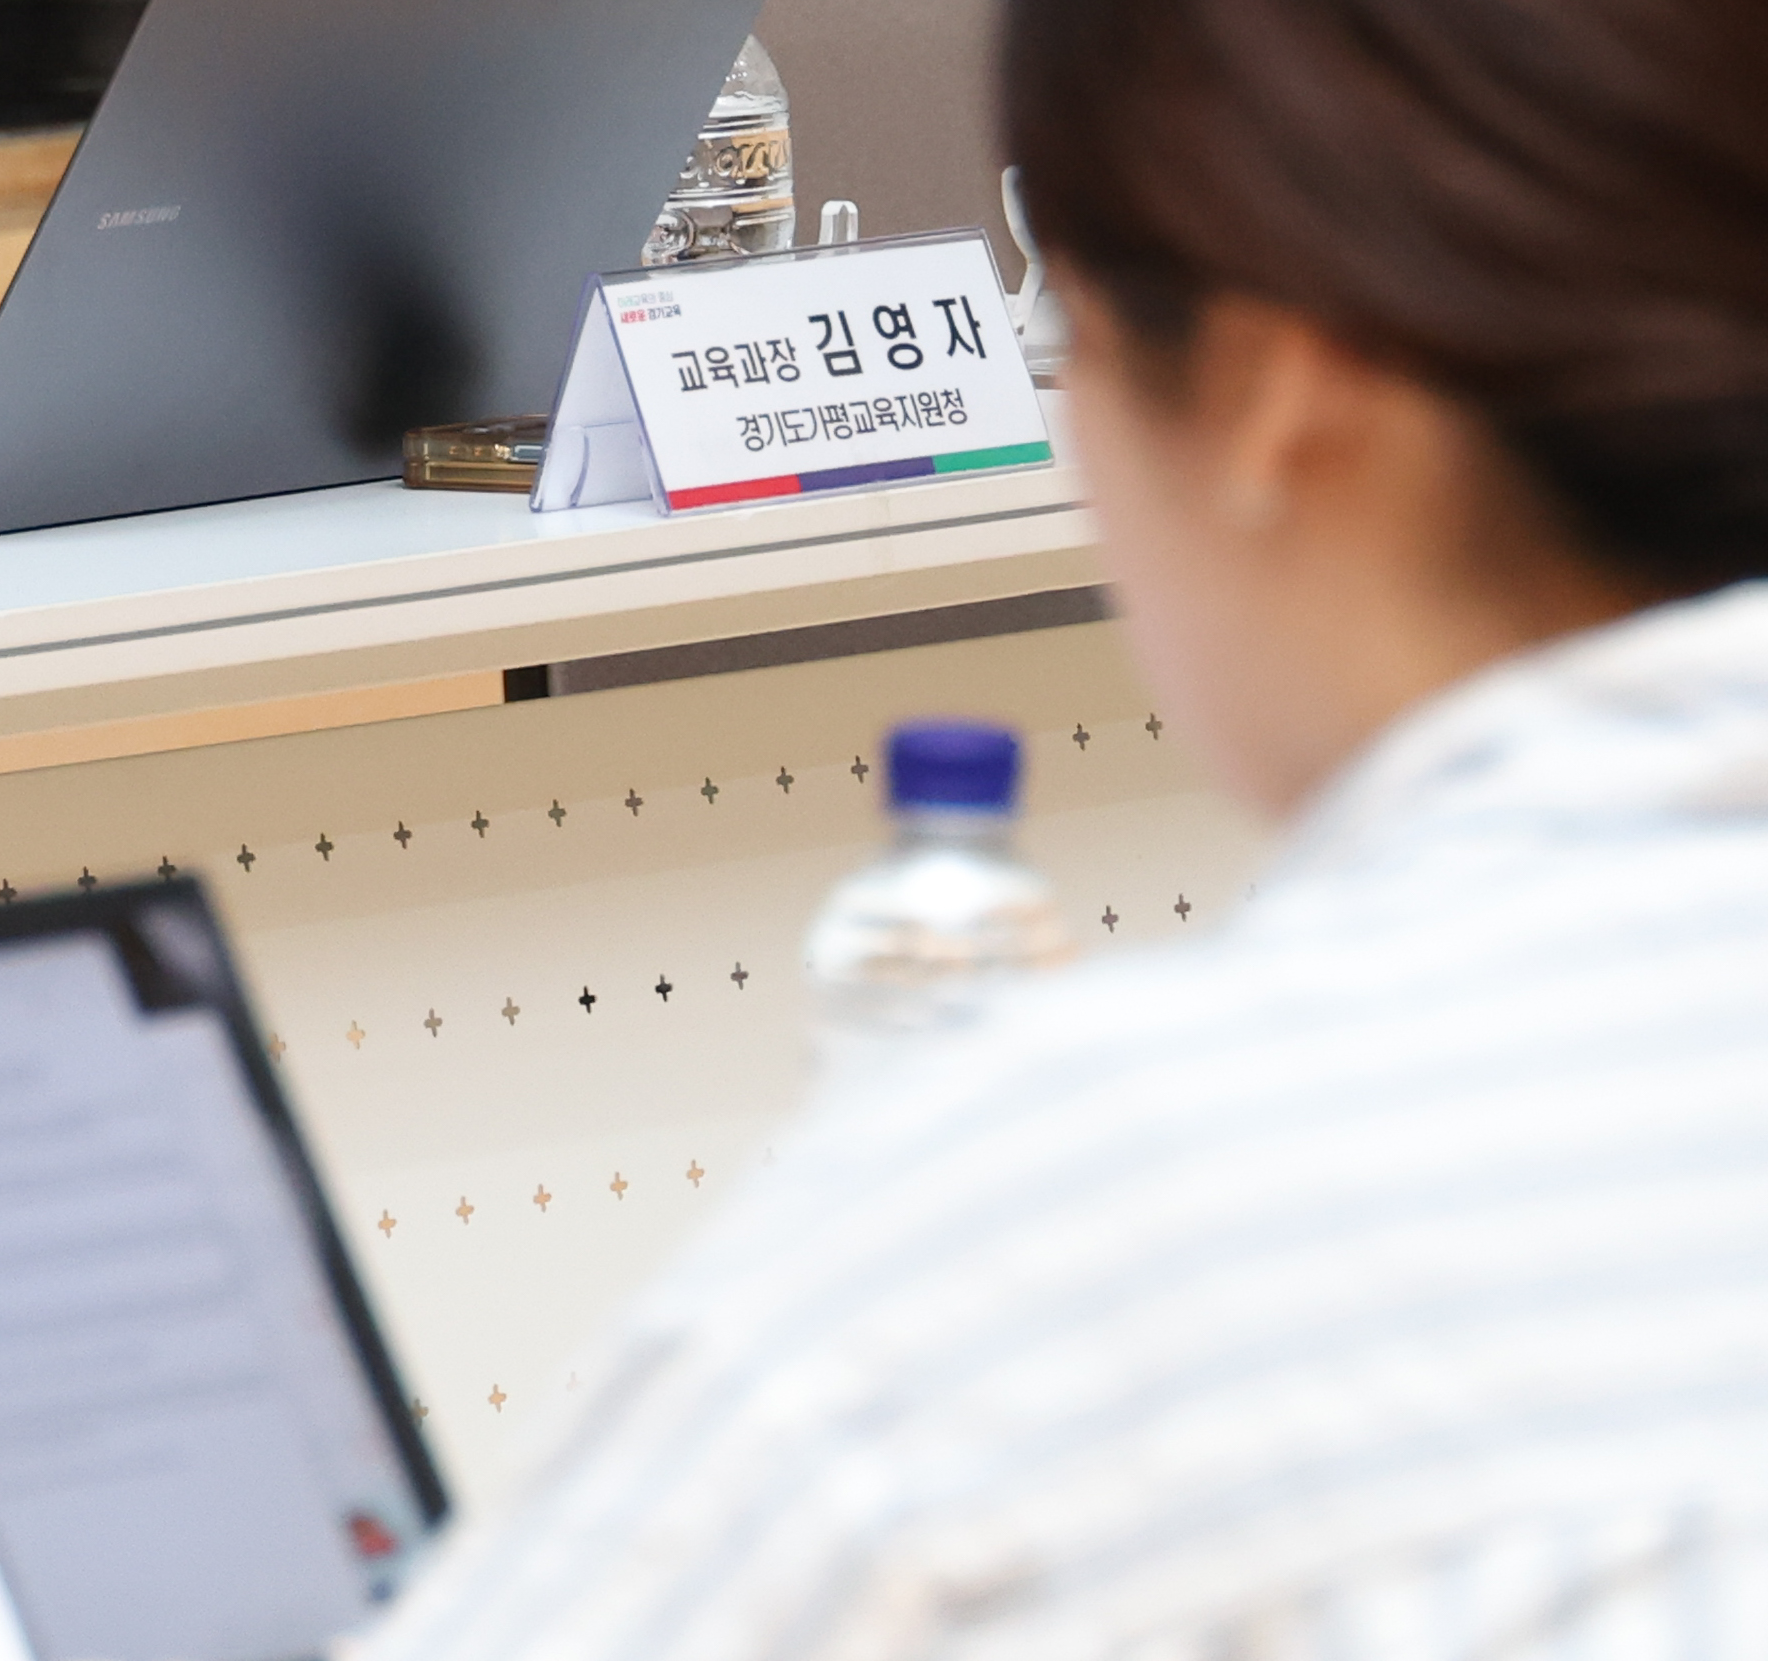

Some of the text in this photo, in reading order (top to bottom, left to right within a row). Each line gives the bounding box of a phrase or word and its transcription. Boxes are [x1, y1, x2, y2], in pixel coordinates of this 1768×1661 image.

[96, 204, 182, 231] SAMSUNG
[670, 337, 802, 392] 교육과장
[736, 388, 968, 452] 경기도가평교육지원청
